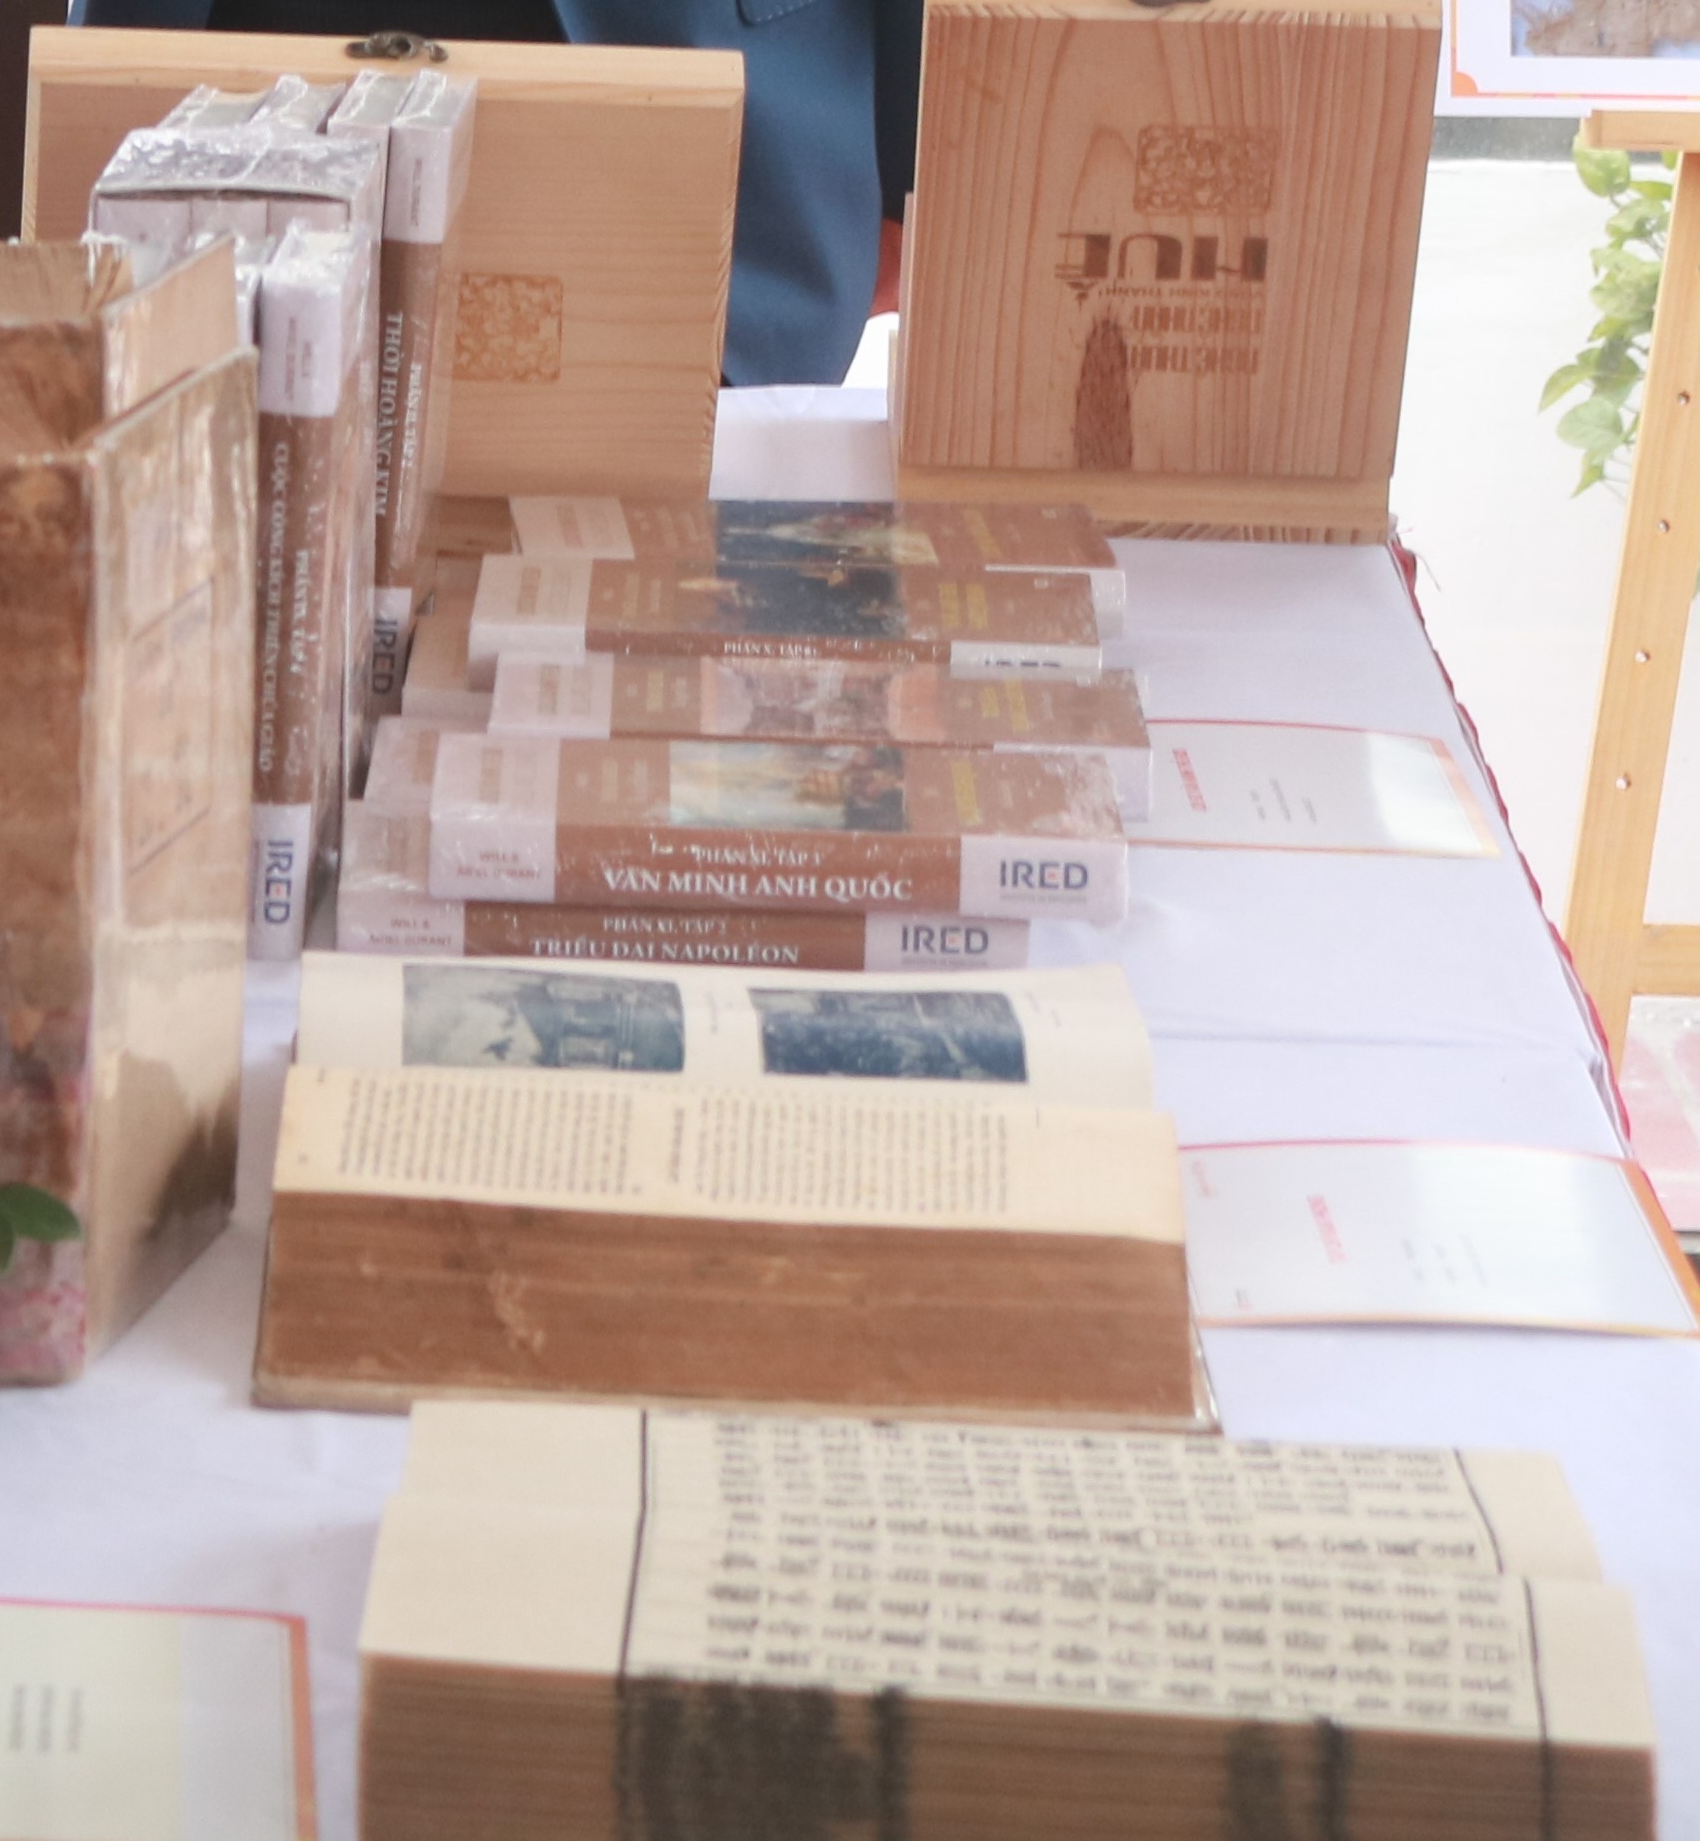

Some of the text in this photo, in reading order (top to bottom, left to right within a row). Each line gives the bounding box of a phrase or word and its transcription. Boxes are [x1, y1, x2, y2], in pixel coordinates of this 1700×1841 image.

[374, 313, 405, 517] THỜI HOÀNG KIM
[271, 442, 289, 497] CUỘC
[270, 500, 287, 556] CÔNG
[373, 620, 397, 694] IRED
[264, 841, 293, 924] IRED
[602, 866, 913, 903] VĂN MINH ANH QUỐC
[1000, 860, 1089, 889] IRED
[604, 916, 651, 933] PHẦN
[902, 925, 989, 955] IRED
[532, 935, 605, 957] TRIỀU
[661, 940, 800, 964] NAPOLÉON
